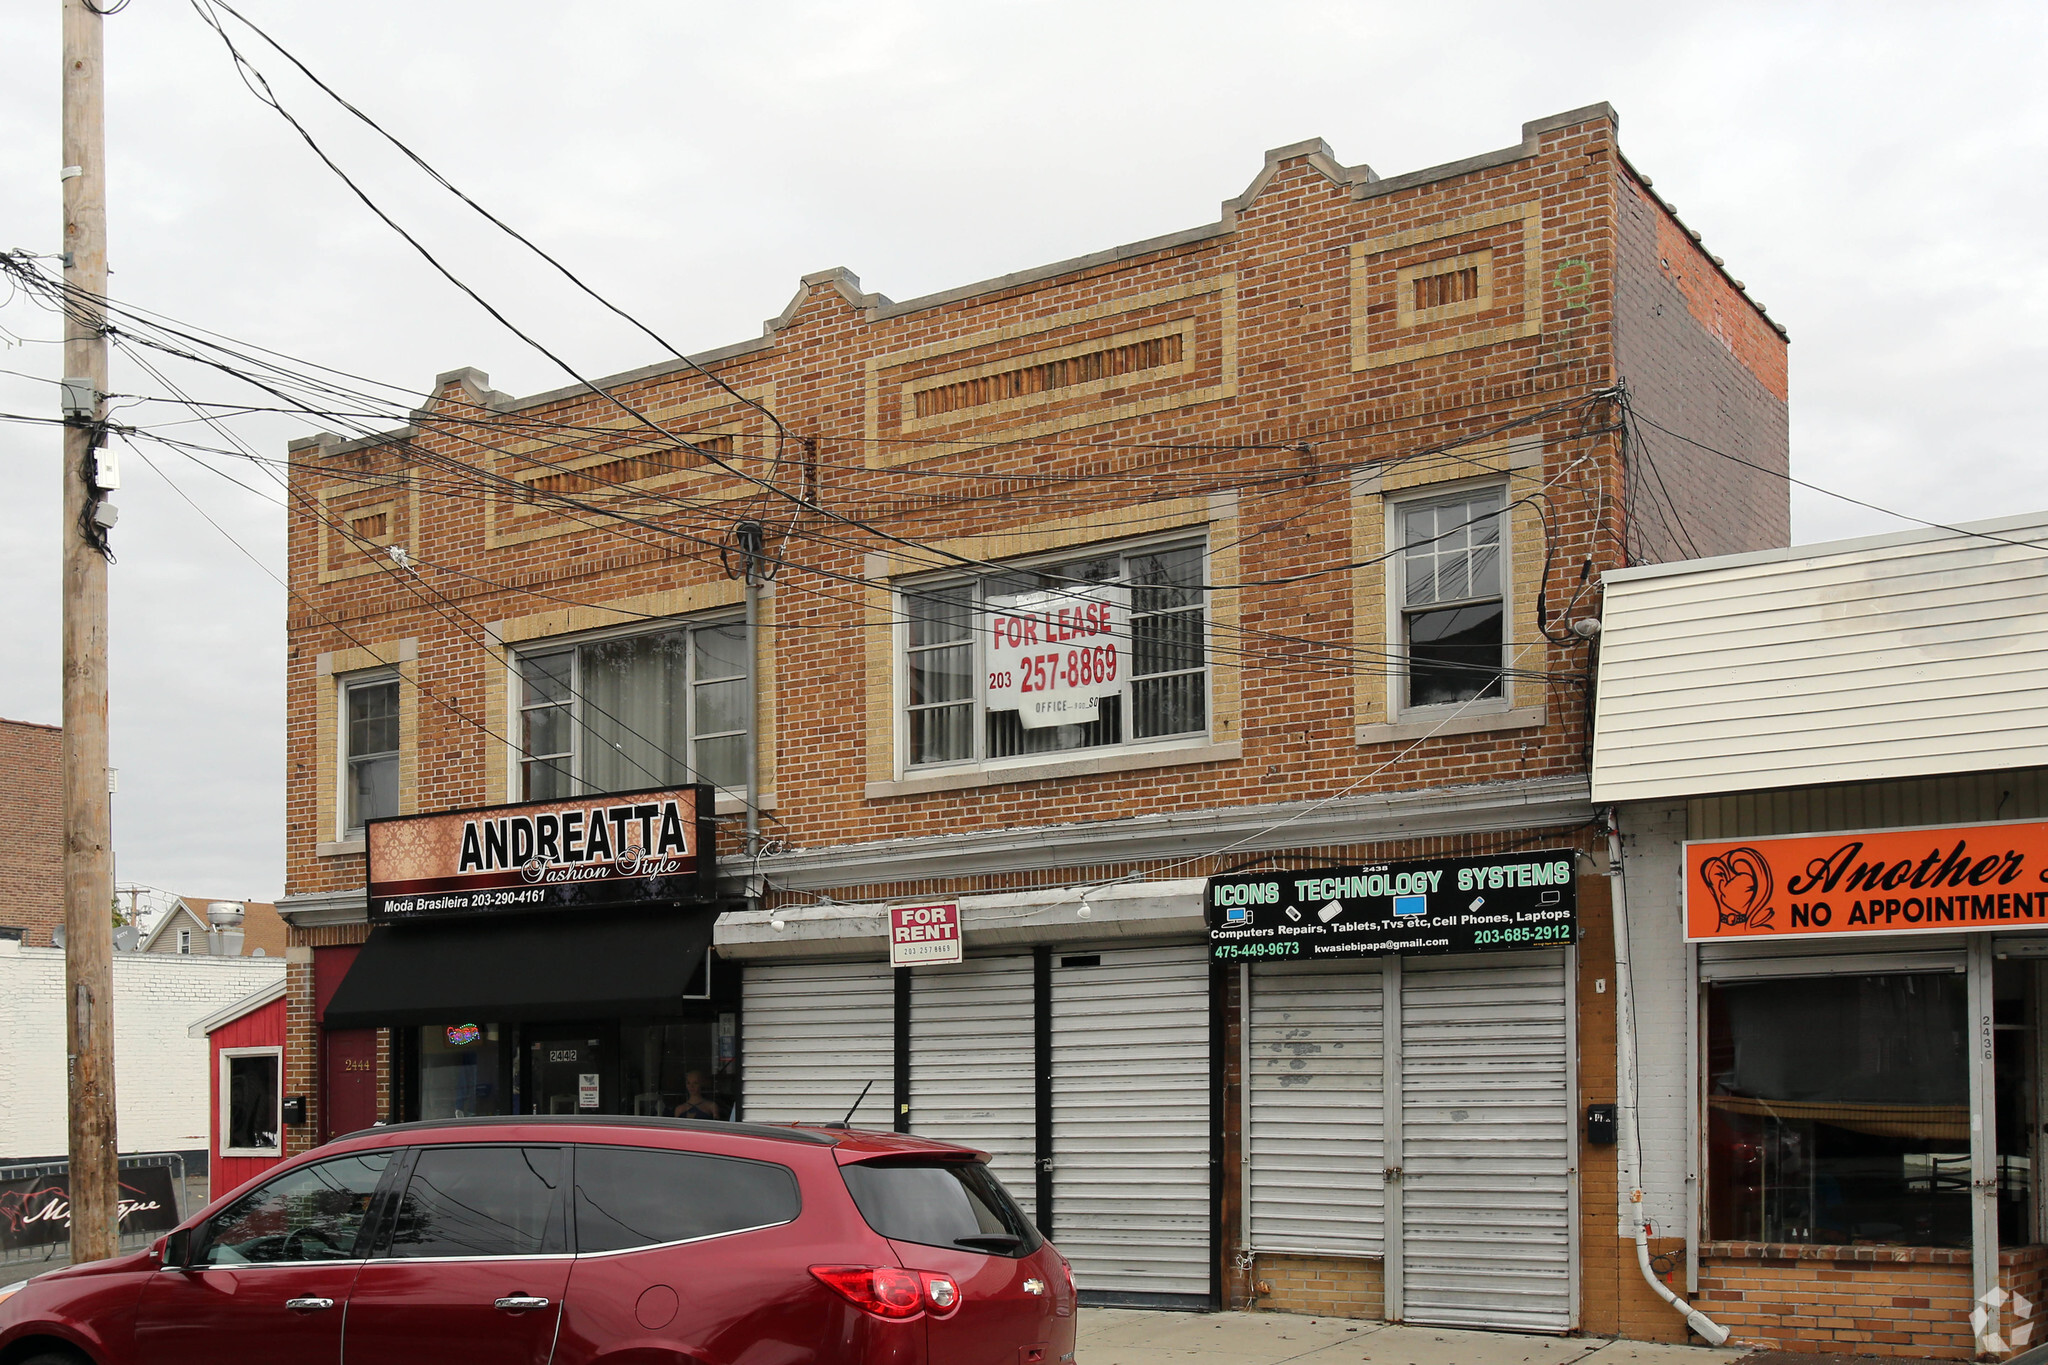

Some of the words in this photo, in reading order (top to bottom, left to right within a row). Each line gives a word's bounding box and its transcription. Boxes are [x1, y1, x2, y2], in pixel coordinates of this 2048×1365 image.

[994, 613, 1038, 650] FOR
[1045, 601, 1112, 643] LEASE
[989, 671, 1012, 690] 203
[1020, 643, 1117, 693] 257-8869
[1035, 700, 1067, 713] OFFICE
[457, 798, 689, 875] ANDREATTA
[521, 854, 610, 885] Fashion
[615, 844, 681, 881] Style
[1362, 865, 1389, 873] 2438
[1787, 839, 2025, 896] Another
[1214, 881, 1279, 907] ICONS
[1295, 870, 1443, 902] TECHNOLOGY
[1457, 861, 1571, 892] SYSTEMS
[384, 897, 414, 913] Moda
[416, 894, 469, 911] Brasileira
[471, 889, 546, 908] 203-290-4161
[1791, 902, 1832, 928] NO
[901, 907, 947, 925] FOR
[1210, 928, 1275, 941] Computers
[1278, 924, 1327, 936] Repairs,
[1460, 912, 1513, 925] Phones,
[1516, 910, 1571, 923] Laptops
[895, 923, 955, 942] RENT
[1214, 941, 1300, 959] 475-449-9673
[1314, 936, 1449, 954] kwasiebipapa@gmail.com
[1474, 925, 1571, 944] 203-685-2912
[904, 947, 916, 956] 203
[920, 946, 932, 954] 257
[1982, 1015, 1993, 1060] 2436
[345, 1058, 371, 1072] 2444
[550, 1050, 576, 1062] 2442
